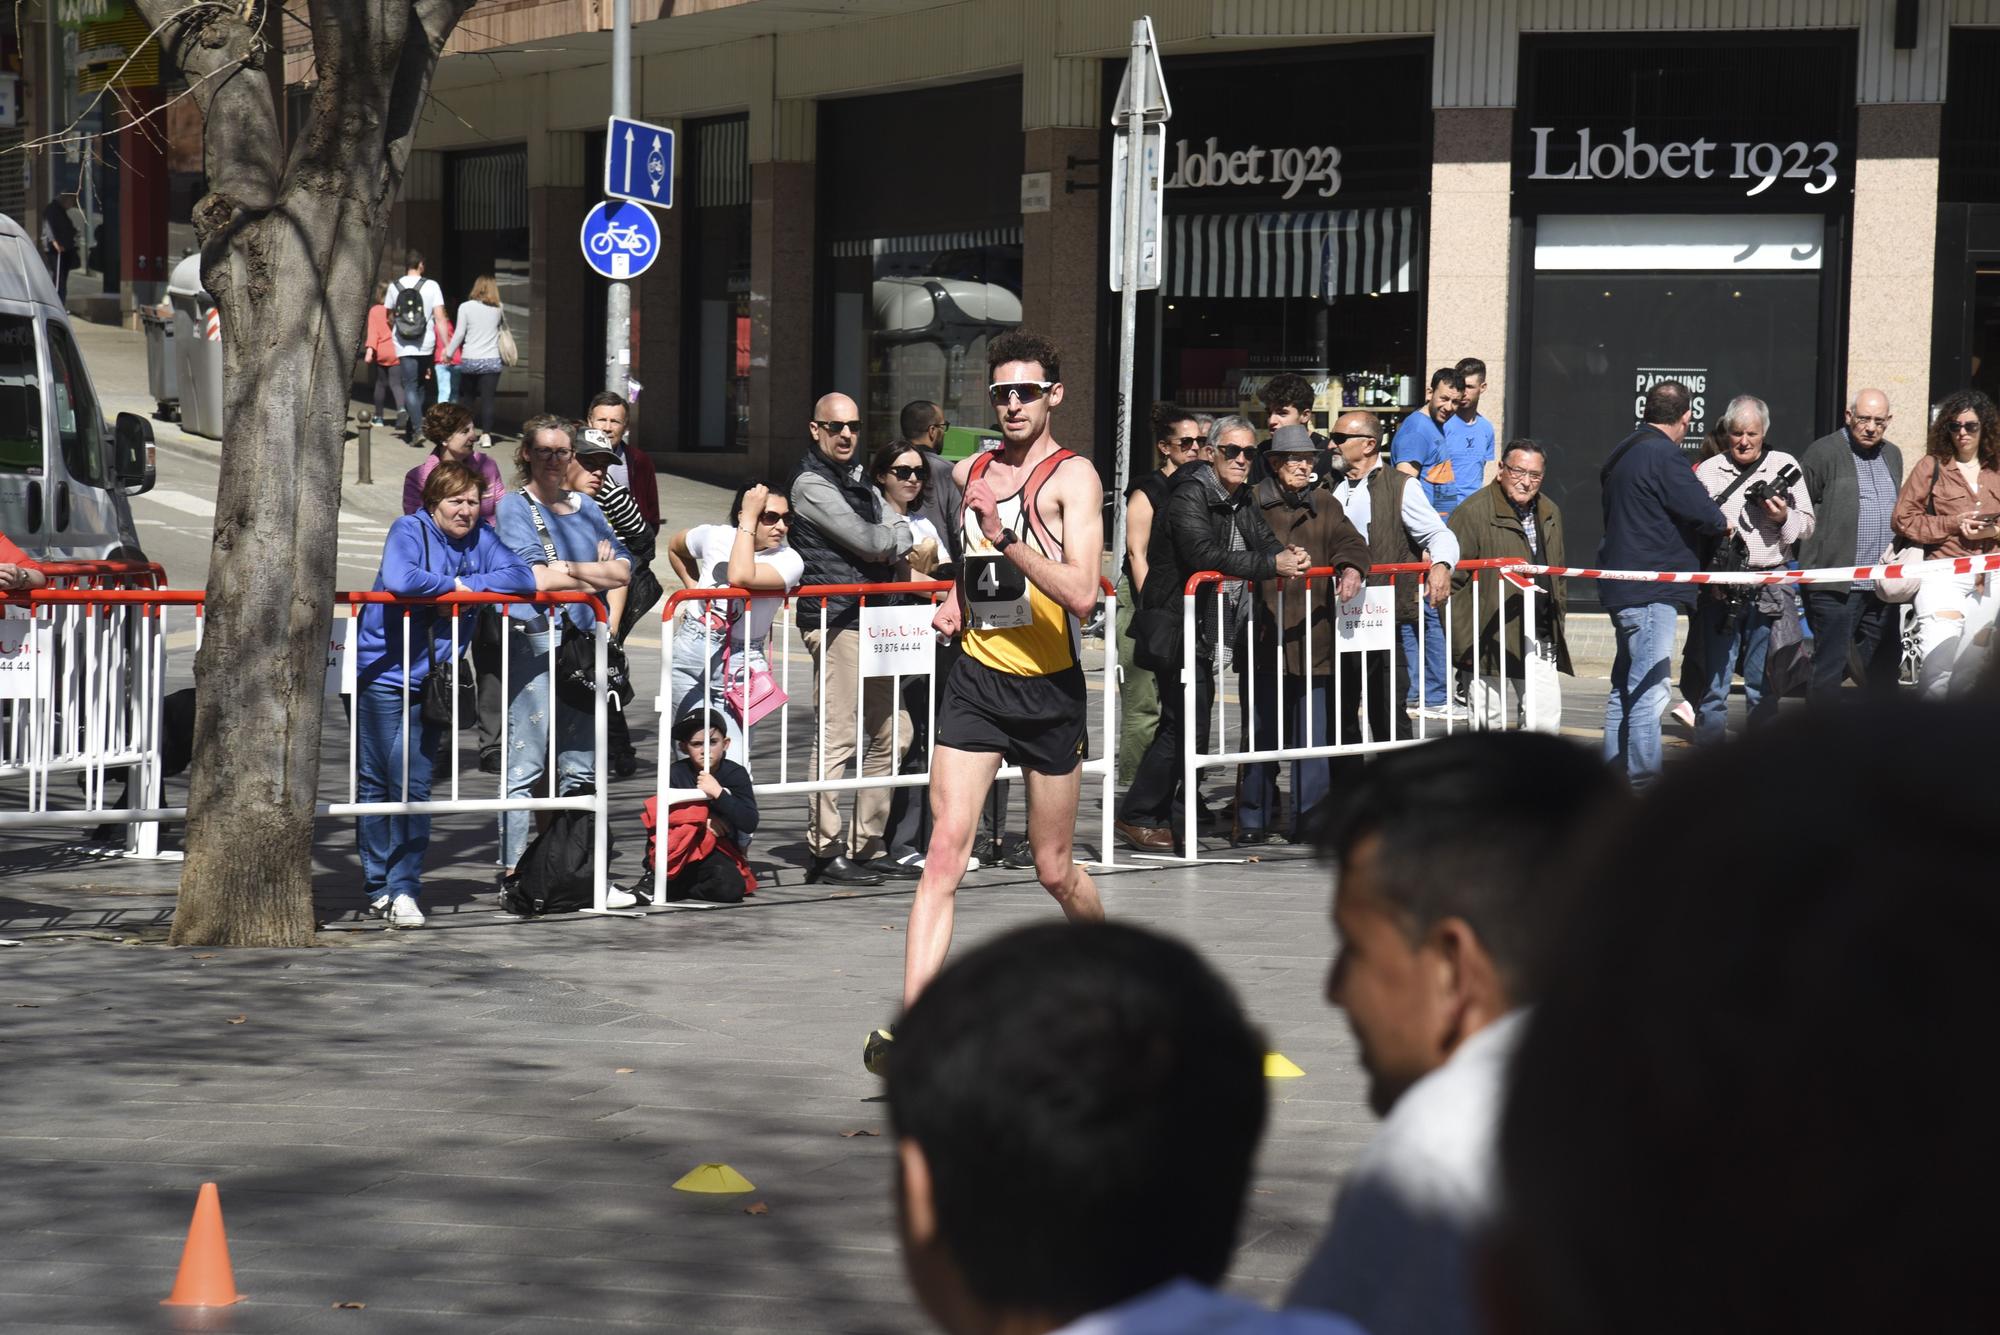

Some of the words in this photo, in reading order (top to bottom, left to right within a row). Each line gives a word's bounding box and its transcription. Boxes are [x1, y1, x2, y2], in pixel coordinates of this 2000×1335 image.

[1269, 146, 1342, 200] 1923
[1528, 127, 1717, 179] Llobet
[1729, 141, 1838, 196] 1923
[543, 543, 559, 562] BIM
[977, 562, 1000, 597] 4
[873, 643, 883, 653] 93
[884, 642, 899, 653] 876
[900, 642, 910, 651] 44
[911, 642, 921, 651] 44
[17, 661, 30, 671] 44
